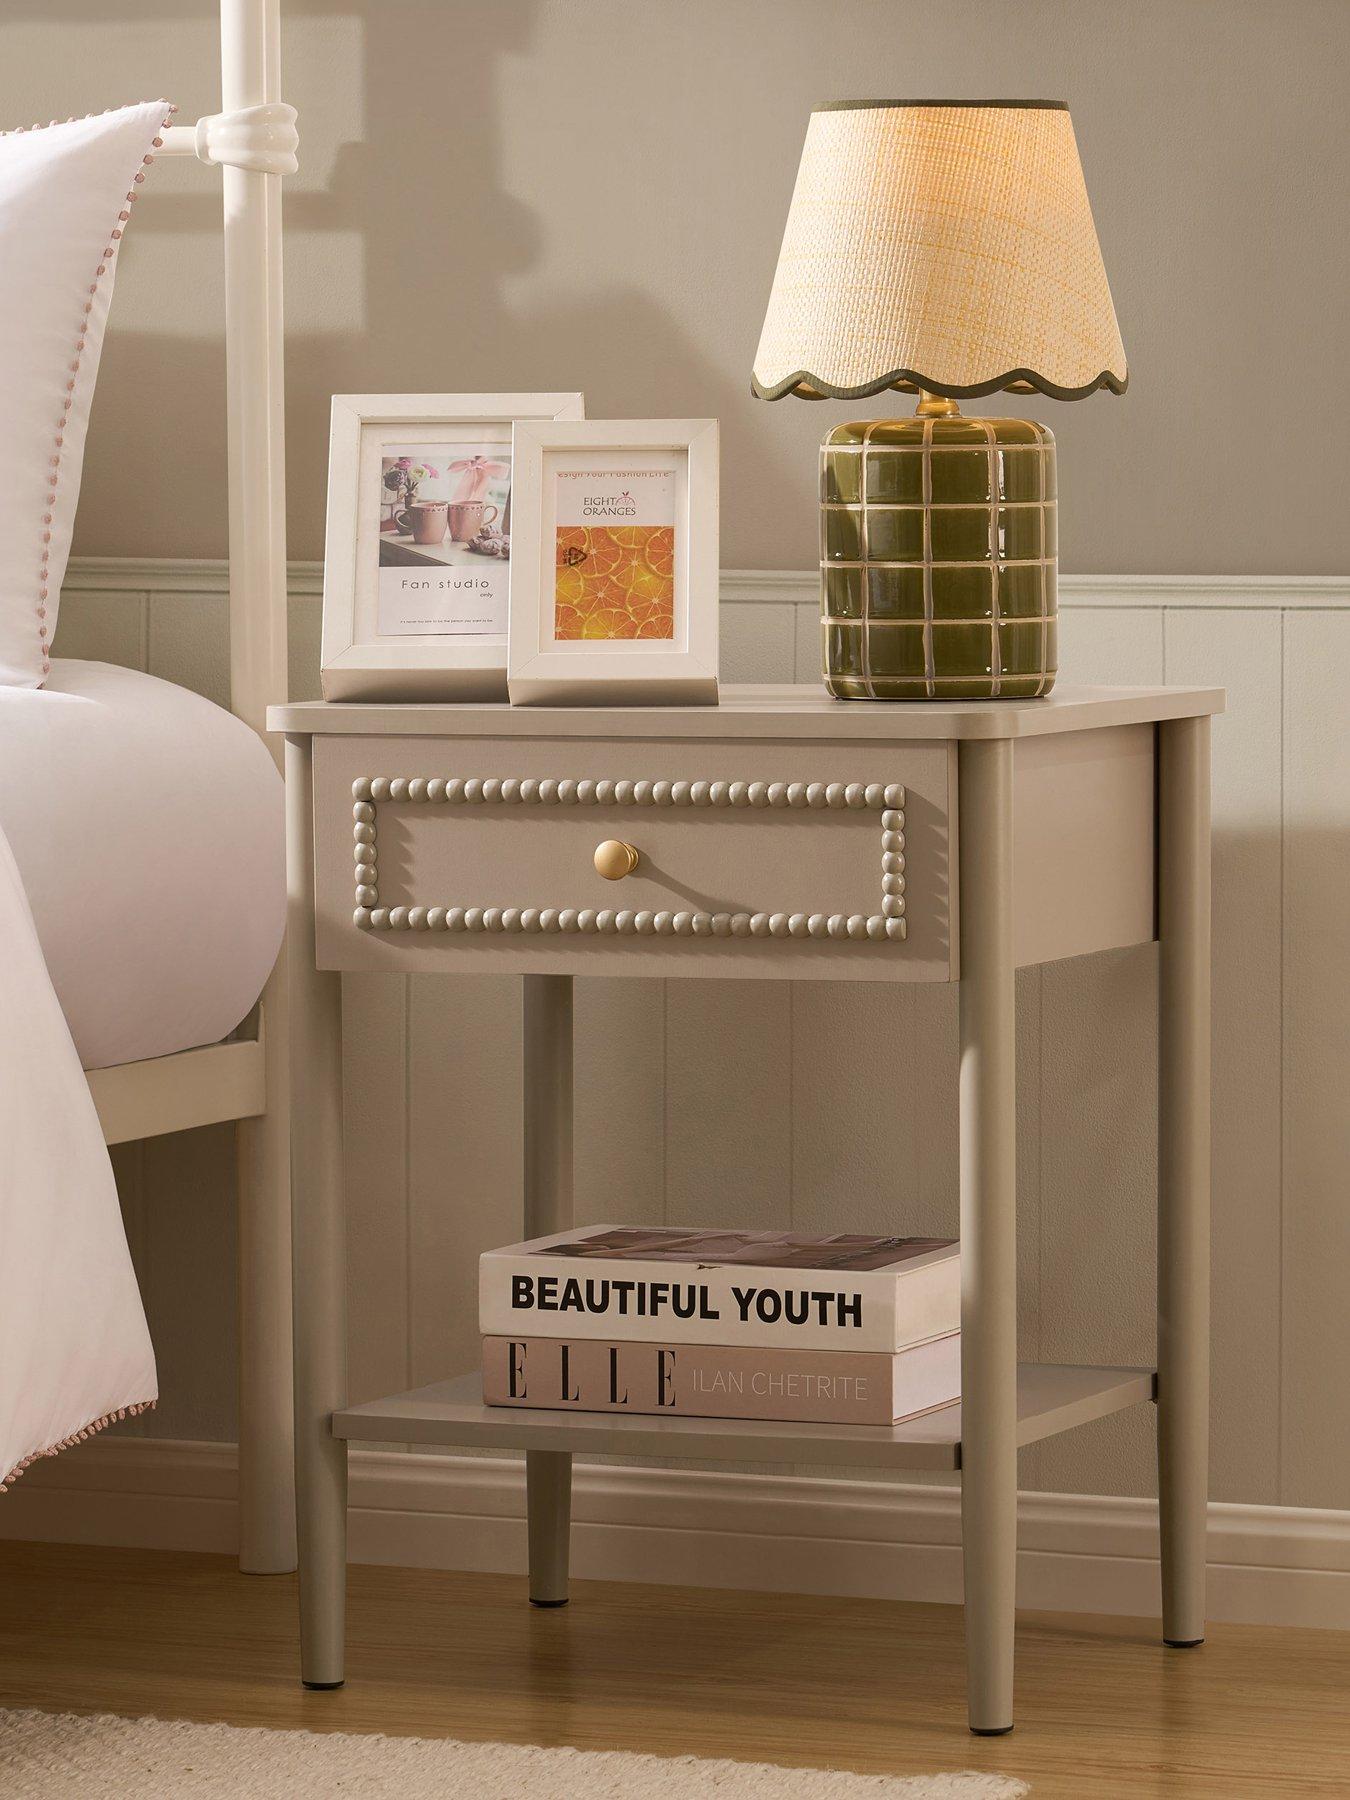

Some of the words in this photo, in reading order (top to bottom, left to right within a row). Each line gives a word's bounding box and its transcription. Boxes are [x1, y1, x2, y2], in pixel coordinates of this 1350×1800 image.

[583, 497, 617, 506] EIGHT
[582, 507, 636, 516] ORANGES
[401, 580, 430, 589] Fan
[438, 579, 489, 589] studio
[511, 1274, 720, 1321] BEAUTIFUL
[731, 1286, 863, 1328] YOUTH
[506, 1342, 677, 1408] ELLE
[692, 1368, 744, 1396] ILAN
[751, 1371, 868, 1401] CHETRITE
